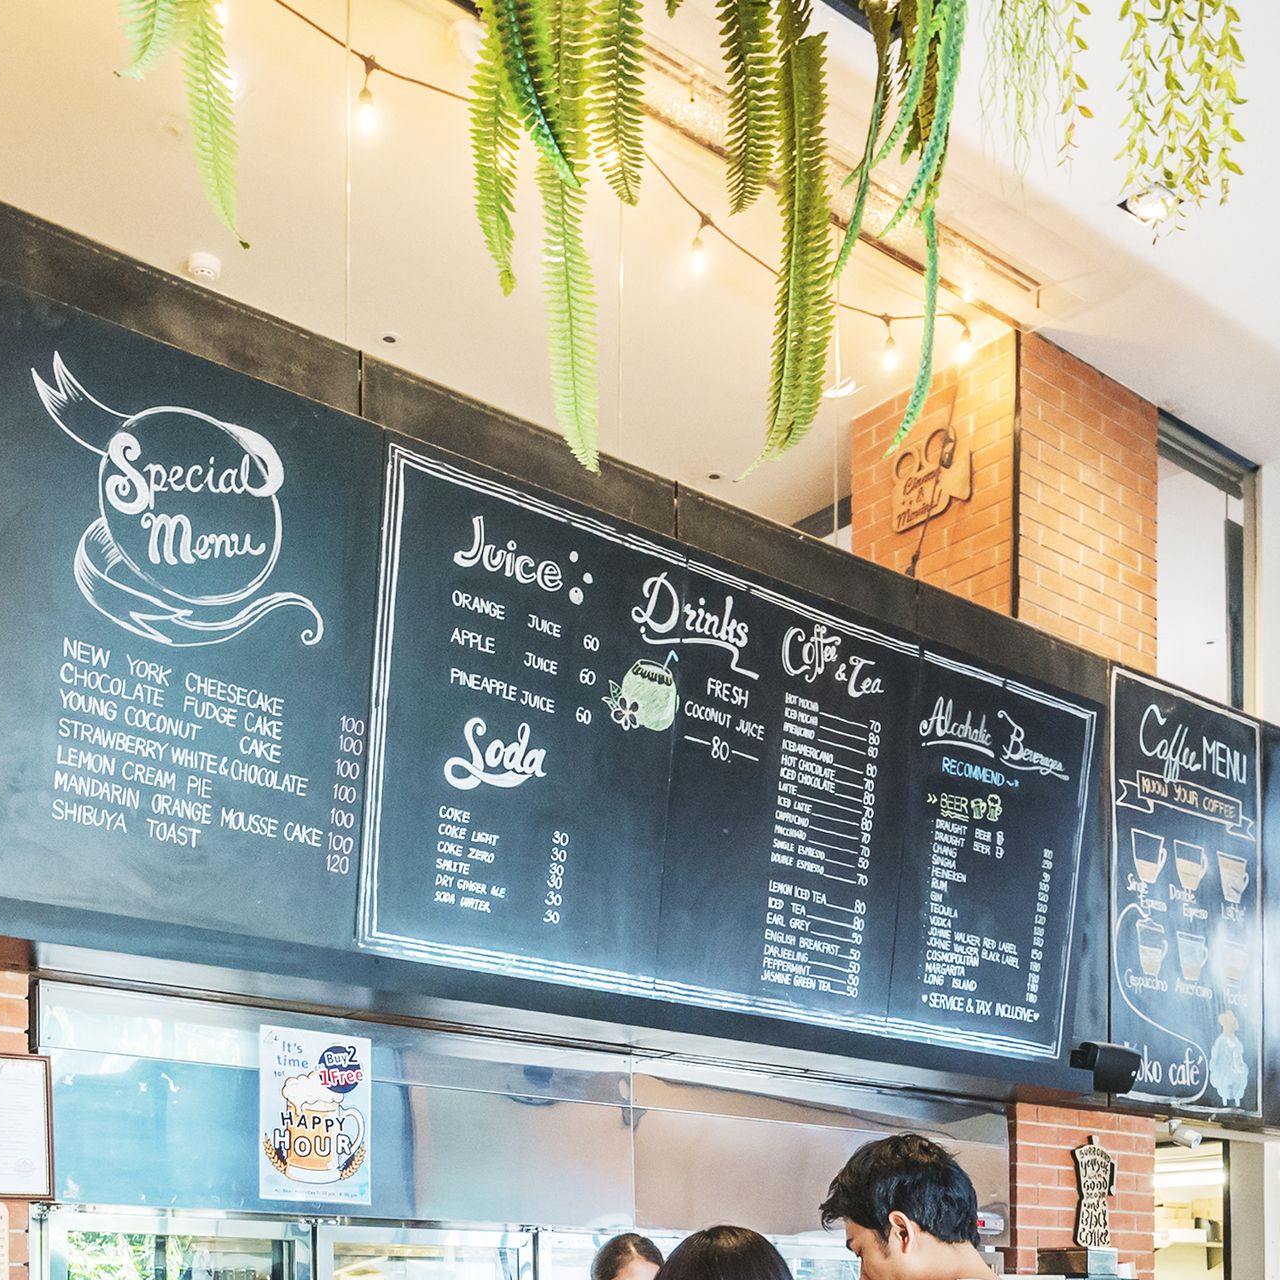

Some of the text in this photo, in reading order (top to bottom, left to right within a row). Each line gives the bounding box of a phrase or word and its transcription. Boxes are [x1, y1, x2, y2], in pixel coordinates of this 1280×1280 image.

[141, 512, 266, 566] Menu
[452, 590, 600, 652] ORANGE JUICE 60
[631, 572, 750, 648] Drinks
[450, 627, 596, 685] APPLE JUICE 60
[63, 637, 365, 736] NEW YORK CHEESECAKE 100
[834, 664, 848, 682] &
[847, 656, 884, 698] Tea
[450, 668, 592, 724] PINEAPPLE JUICE 60
[706, 677, 749, 709] FRESH
[60, 662, 363, 756] CHOCOLATE FUDGE CAKE 100
[684, 700, 765, 741] COCONUT JUICE
[59, 689, 360, 780] YOUNG COCONUT CAKE 100
[1140, 704, 1247, 784] Coffee MENU
[58, 719, 168, 762] STRAWBERRY
[333, 784, 357, 804] 100
[444, 717, 547, 791] Soda
[781, 754, 836, 780] HOT CHOCOLATE
[780, 767, 836, 793] ICED CHOCOLATE
[941, 756, 1005, 787] RECOMMEND
[56, 745, 354, 829] LEMON CREAM PIE 100
[1173, 783, 1199, 808] YOUR
[1202, 797, 1236, 819] COFFEE
[54, 770, 353, 855] MANDARIN ORANGE MOUSSE CAKE 100
[940, 793, 969, 814] BEER
[52, 799, 350, 874] SHIBUYA TOAST 120
[439, 805, 569, 846] COKE 30
[934, 831, 966, 847] DRAUGHT
[935, 819, 992, 842] DRAUGHT BEER
[438, 823, 567, 862] COKE LIGHT 30
[932, 842, 957, 858] CHANG
[437, 841, 564, 876] COKE ZERO 30
[931, 854, 957, 869] SINGHA
[435, 858, 563, 890] SPRITE 30
[931, 866, 967, 883] HEINEKEN
[435, 873, 455, 888] DRY
[456, 879, 487, 895] GINGER
[544, 890, 562, 906] 30
[768, 880, 827, 905] LEMON ICED TEA
[434, 891, 560, 924] SODA WATER 30
[768, 897, 806, 915] ICED TEA
[929, 902, 958, 919] TEQUILA
[766, 912, 811, 931] EARL GREY
[929, 915, 951, 928] VODKA
[764, 944, 809, 962] DARJEELING
[765, 929, 840, 957] ENGLISH BREAKFAST
[926, 949, 979, 967] COSMOPOLITAN
[982, 937, 1018, 955] RED LABEL
[762, 957, 811, 975] PEPPERMINT
[925, 962, 965, 977] MARGARITA
[981, 949, 1020, 969] BLACK LABEL
[761, 970, 832, 992] JASMINE GREEN TEA
[923, 973, 977, 991] LONG ISLAND
[928, 992, 1035, 1023] SERVICE & TAX INCLUSIVE
[276, 1056, 309, 1069] time
[282, 1041, 303, 1054] It's
[325, 1051, 350, 1067] Buy
[330, 1070, 364, 1086] Free
[1168, 1047, 1203, 1087] café
[281, 1111, 346, 1133] HAPPY
[273, 1128, 352, 1158] HOUR
